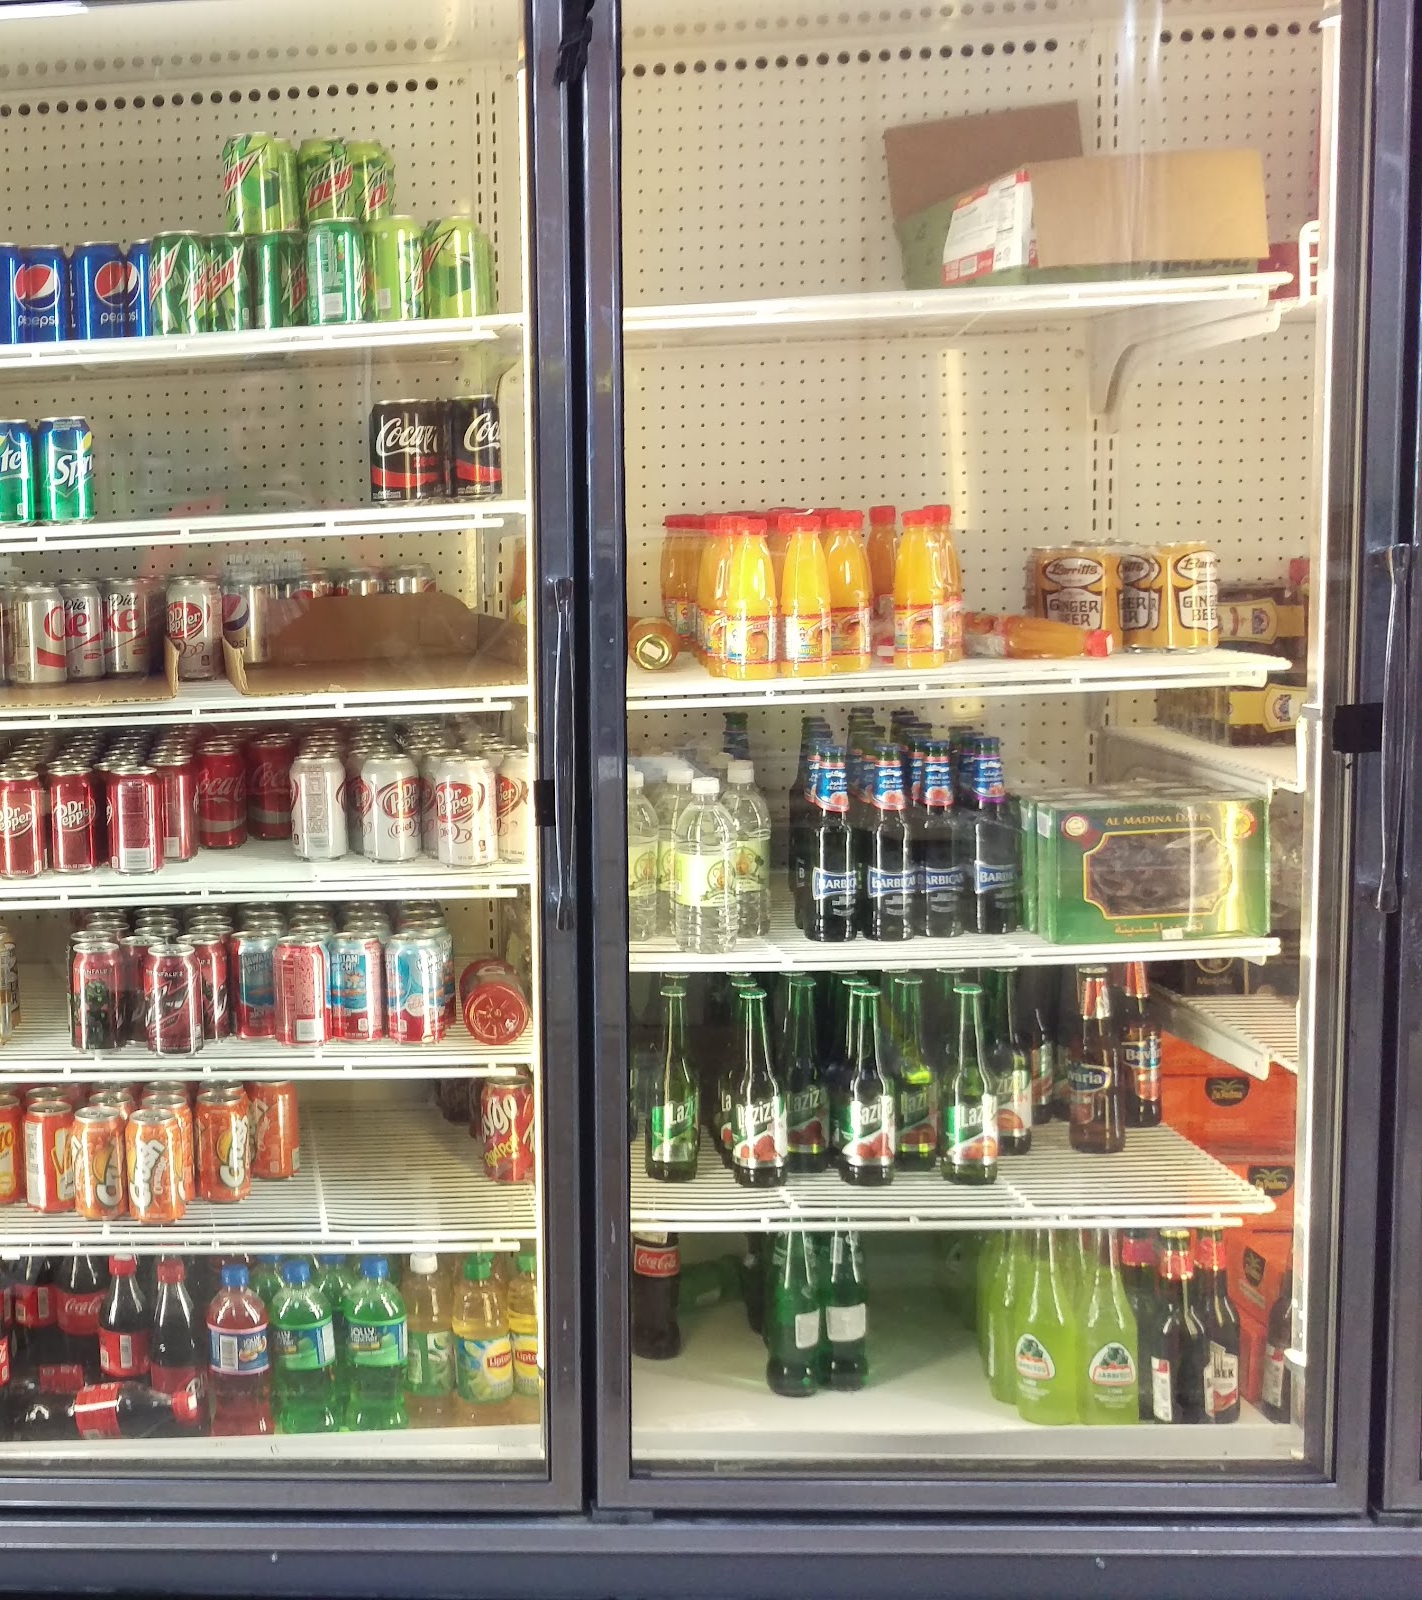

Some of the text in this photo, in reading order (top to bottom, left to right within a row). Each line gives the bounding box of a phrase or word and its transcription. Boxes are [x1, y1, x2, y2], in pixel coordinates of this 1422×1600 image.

[1181, 558, 1218, 572] Barri
[108, 592, 138, 608] Diet
[1050, 600, 1099, 614] GINGER
[1182, 595, 1218, 609] GING
[1192, 609, 1218, 621] BEE
[405, 783, 417, 796] Dr
[445, 789, 461, 801] Dr
[390, 786, 419, 811] Pepp
[436, 791, 475, 817] Pepper
[4, 806, 21, 819] Dr
[67, 800, 85, 814] Dr
[1106, 816, 1120, 826] AL
[1123, 815, 1171, 826] MADINA
[819, 876, 856, 889] BARBIC
[489, 1352, 511, 1367] Lipton
[517, 1352, 537, 1364] Lipto
